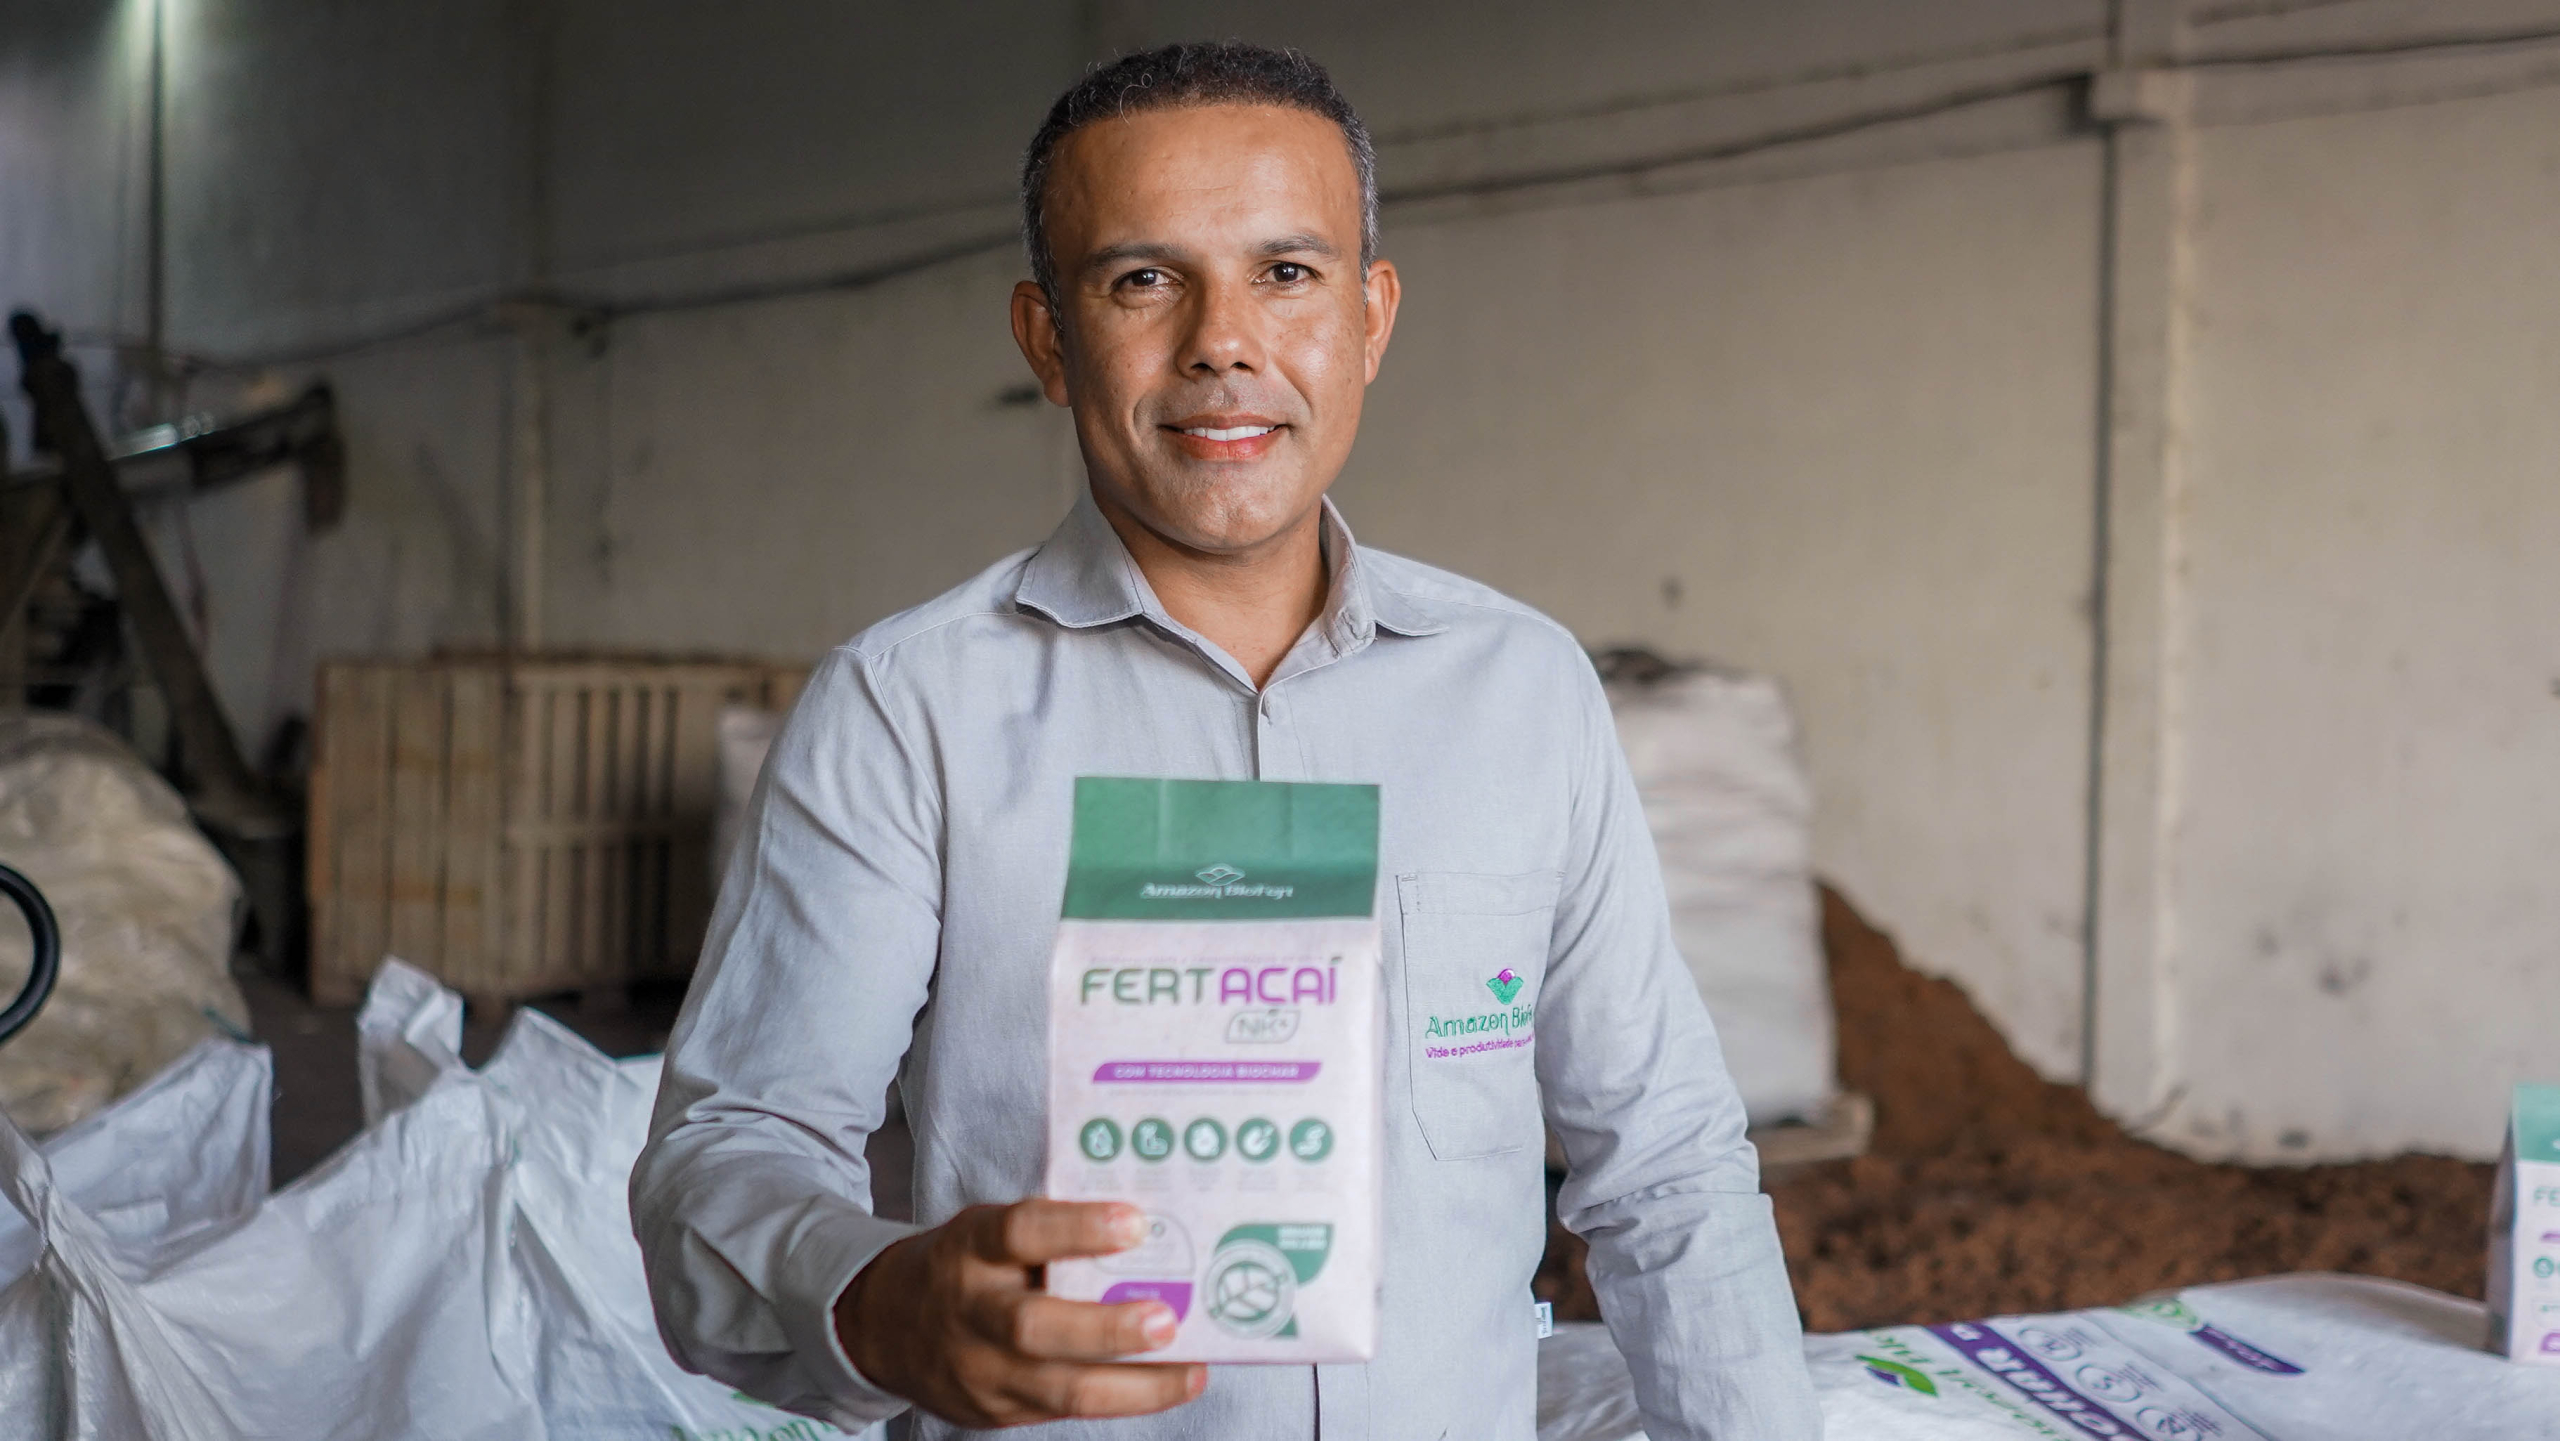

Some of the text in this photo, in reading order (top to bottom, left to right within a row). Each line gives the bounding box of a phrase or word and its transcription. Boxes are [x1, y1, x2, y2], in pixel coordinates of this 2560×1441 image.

[1425, 1012, 1510, 1039] Amazon
[1114, 1063, 1146, 1078] COM
[1149, 1063, 1234, 1078] TECNOLOGIA
